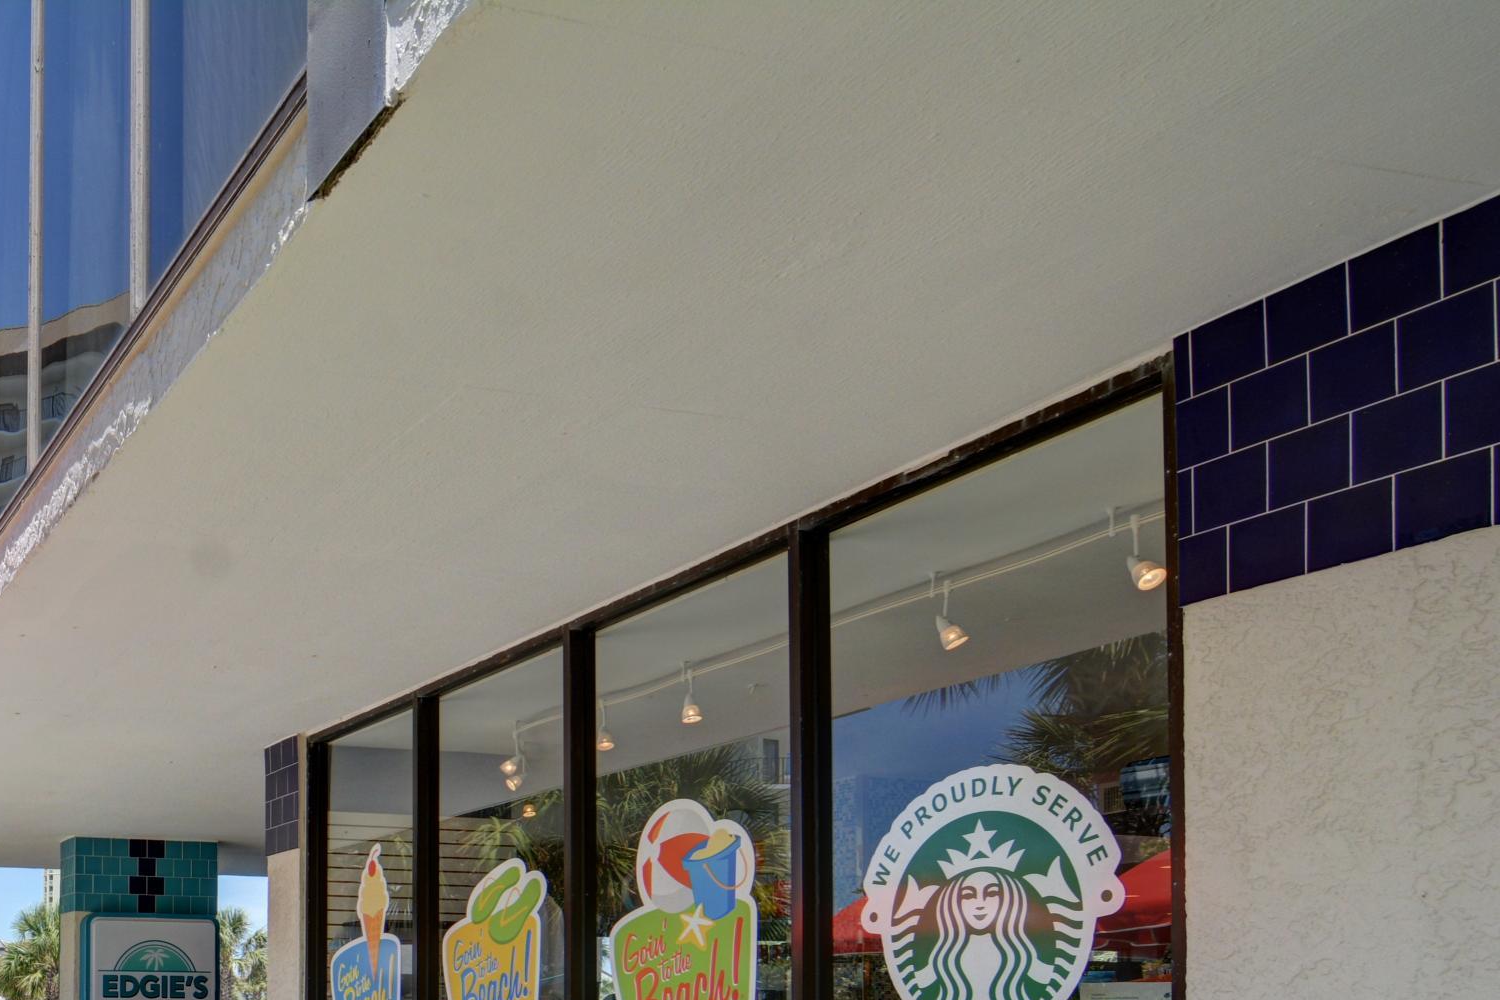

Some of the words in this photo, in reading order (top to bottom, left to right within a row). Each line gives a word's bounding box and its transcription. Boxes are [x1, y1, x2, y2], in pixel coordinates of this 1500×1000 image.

[872, 844, 901, 888] WE
[900, 775, 1024, 840] PROUDLY
[1031, 784, 1109, 867] SERVE
[452, 927, 484, 973] Goin'
[476, 959, 486, 978] to
[485, 952, 498, 973] the
[622, 917, 669, 975] Goin'
[659, 959, 673, 982] to
[672, 946, 692, 975] the
[102, 974, 209, 1000] EDGIE'S
[338, 953, 361, 992] Goin'
